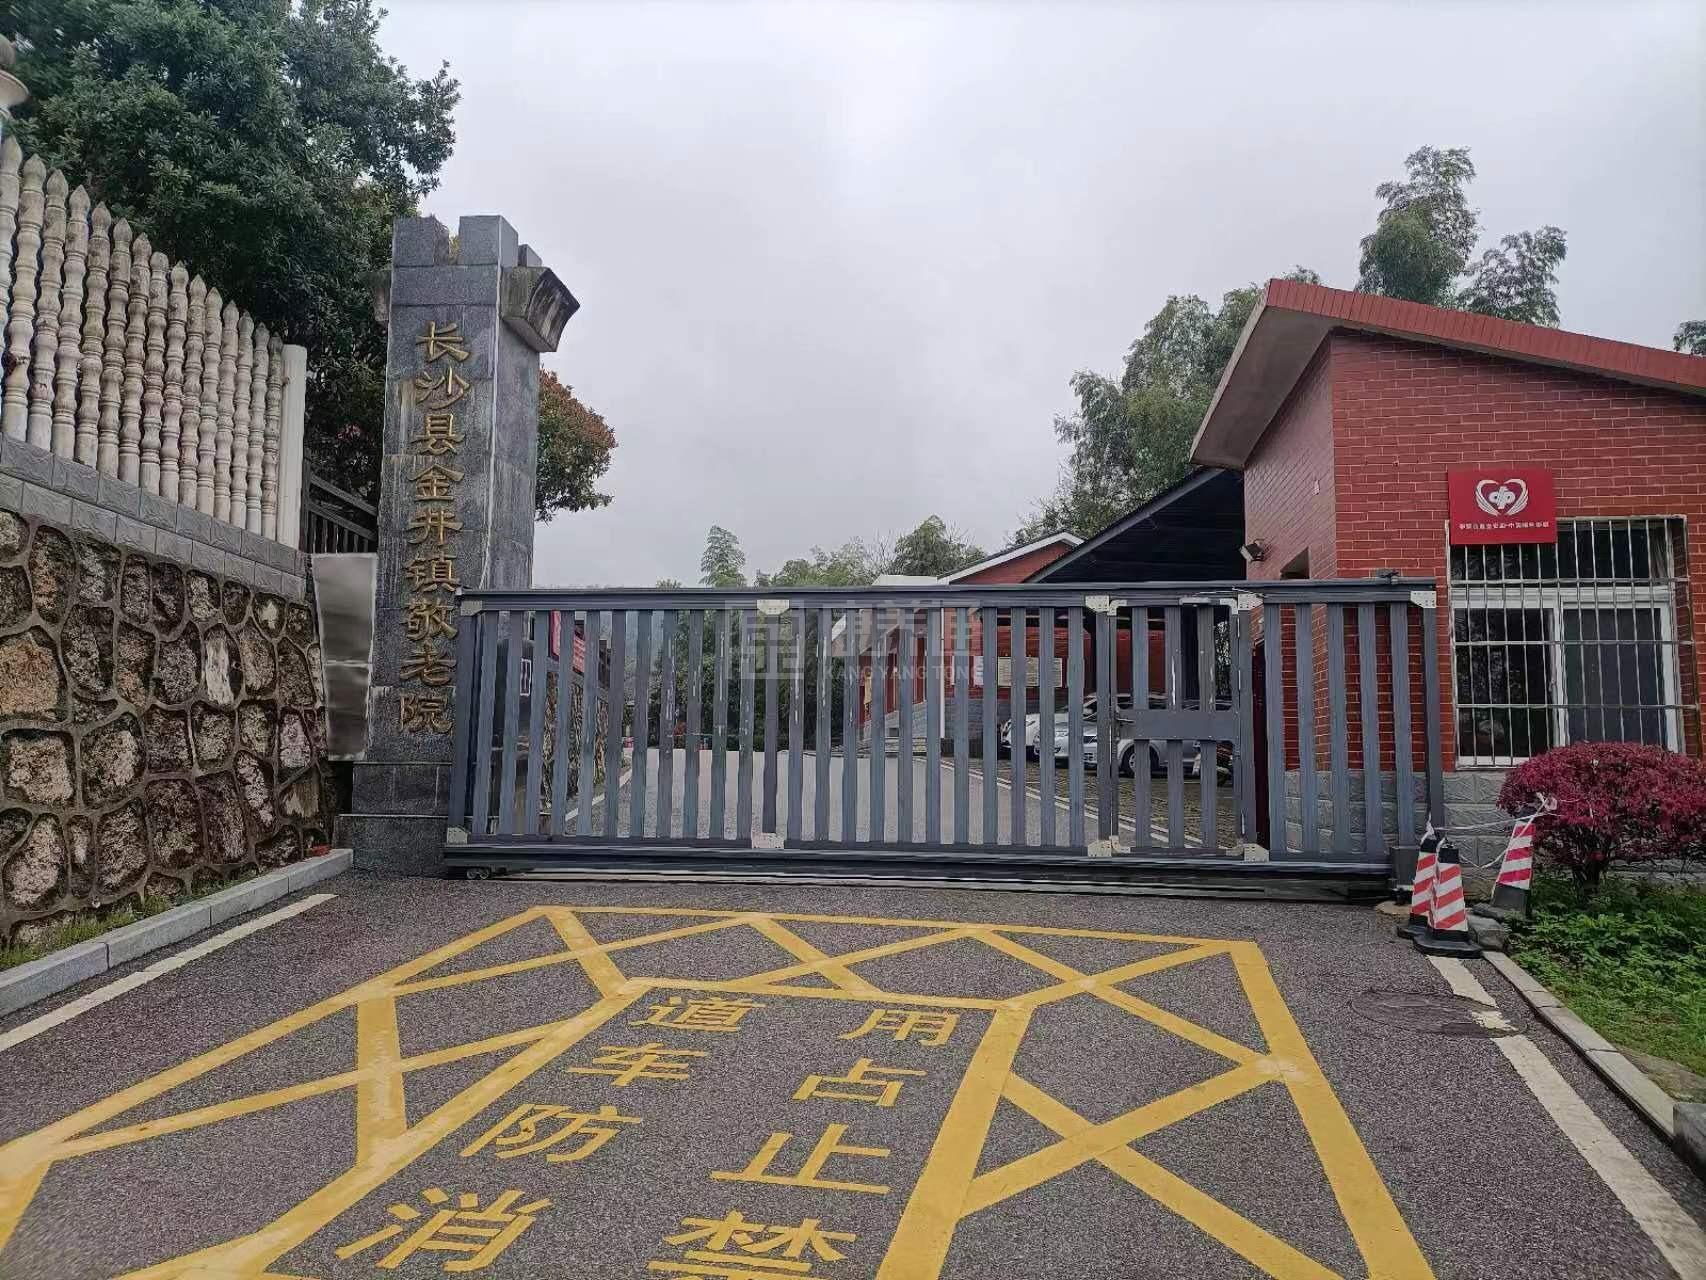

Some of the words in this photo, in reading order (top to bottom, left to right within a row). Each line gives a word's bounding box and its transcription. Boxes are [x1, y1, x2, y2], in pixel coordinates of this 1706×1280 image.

[397, 321, 470, 734] 长沙县金井镇敬老院
